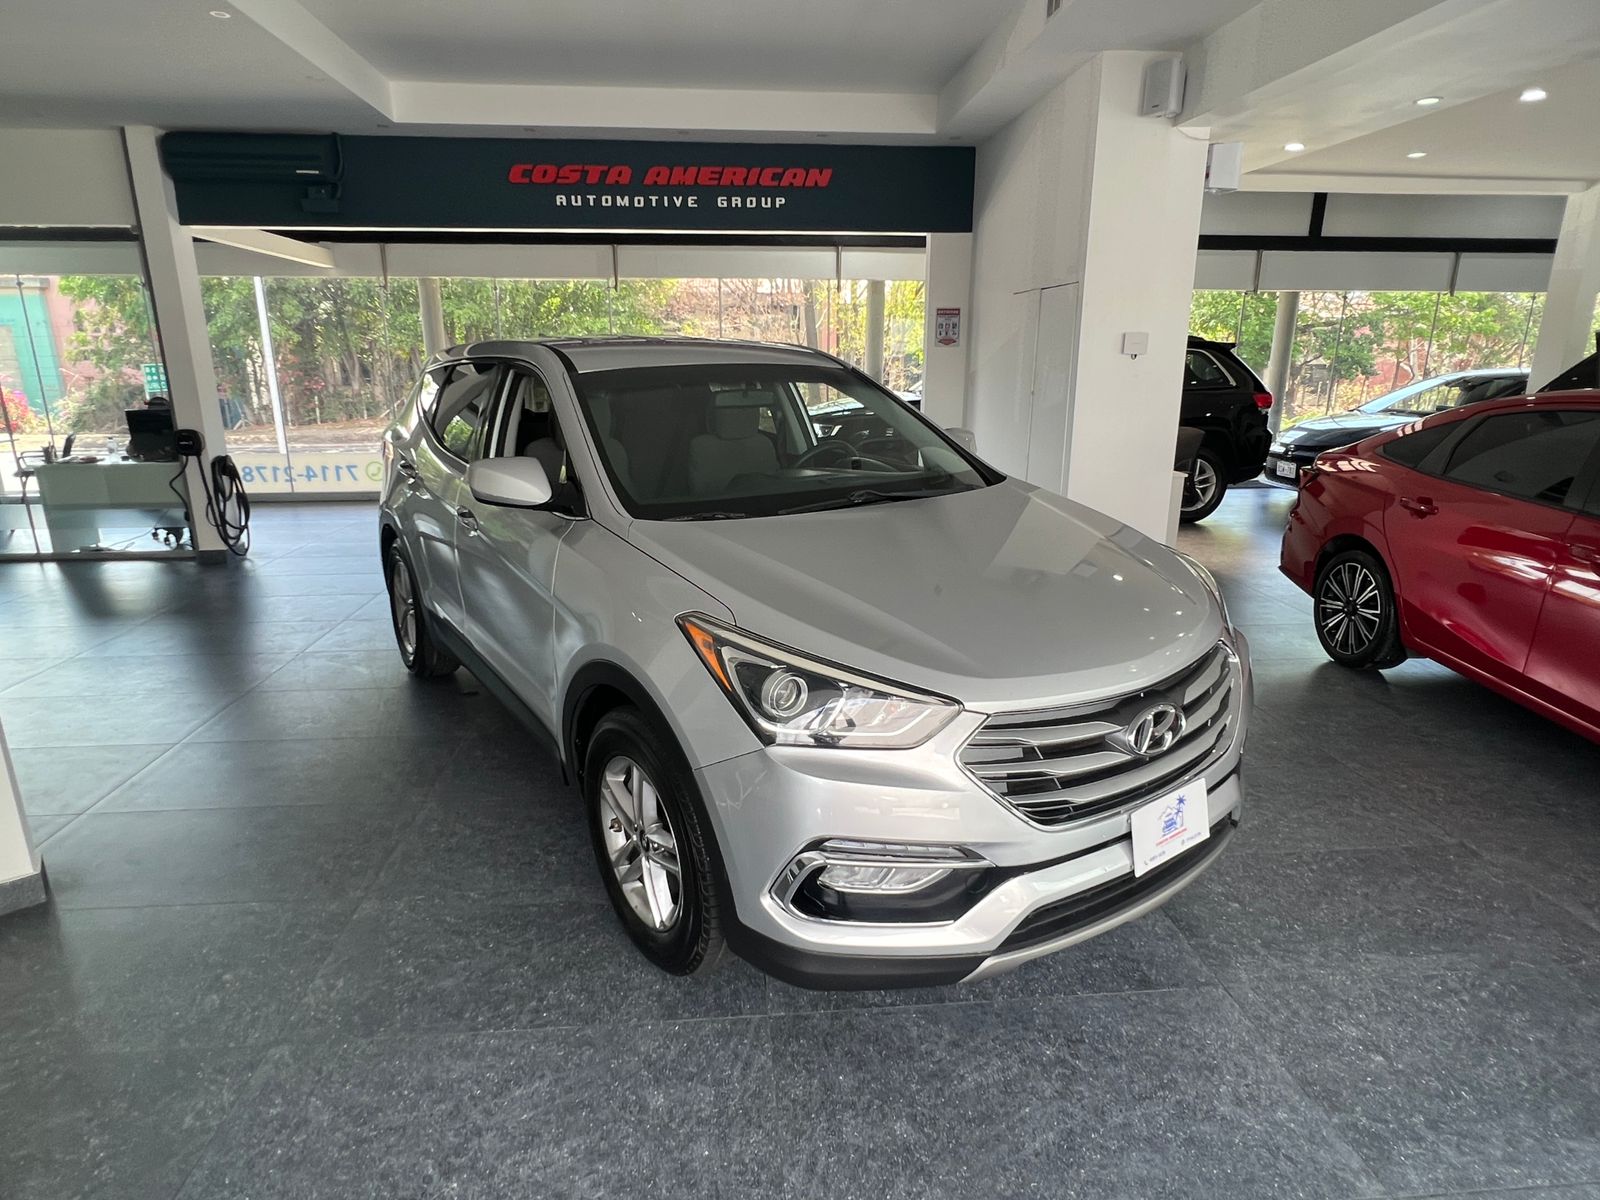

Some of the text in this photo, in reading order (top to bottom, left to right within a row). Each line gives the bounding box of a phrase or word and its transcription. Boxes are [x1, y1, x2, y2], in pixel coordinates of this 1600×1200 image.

[508, 163, 833, 187] COSTA AMERICAN
[555, 194, 786, 209] AUTOMOTIVE GROUP
